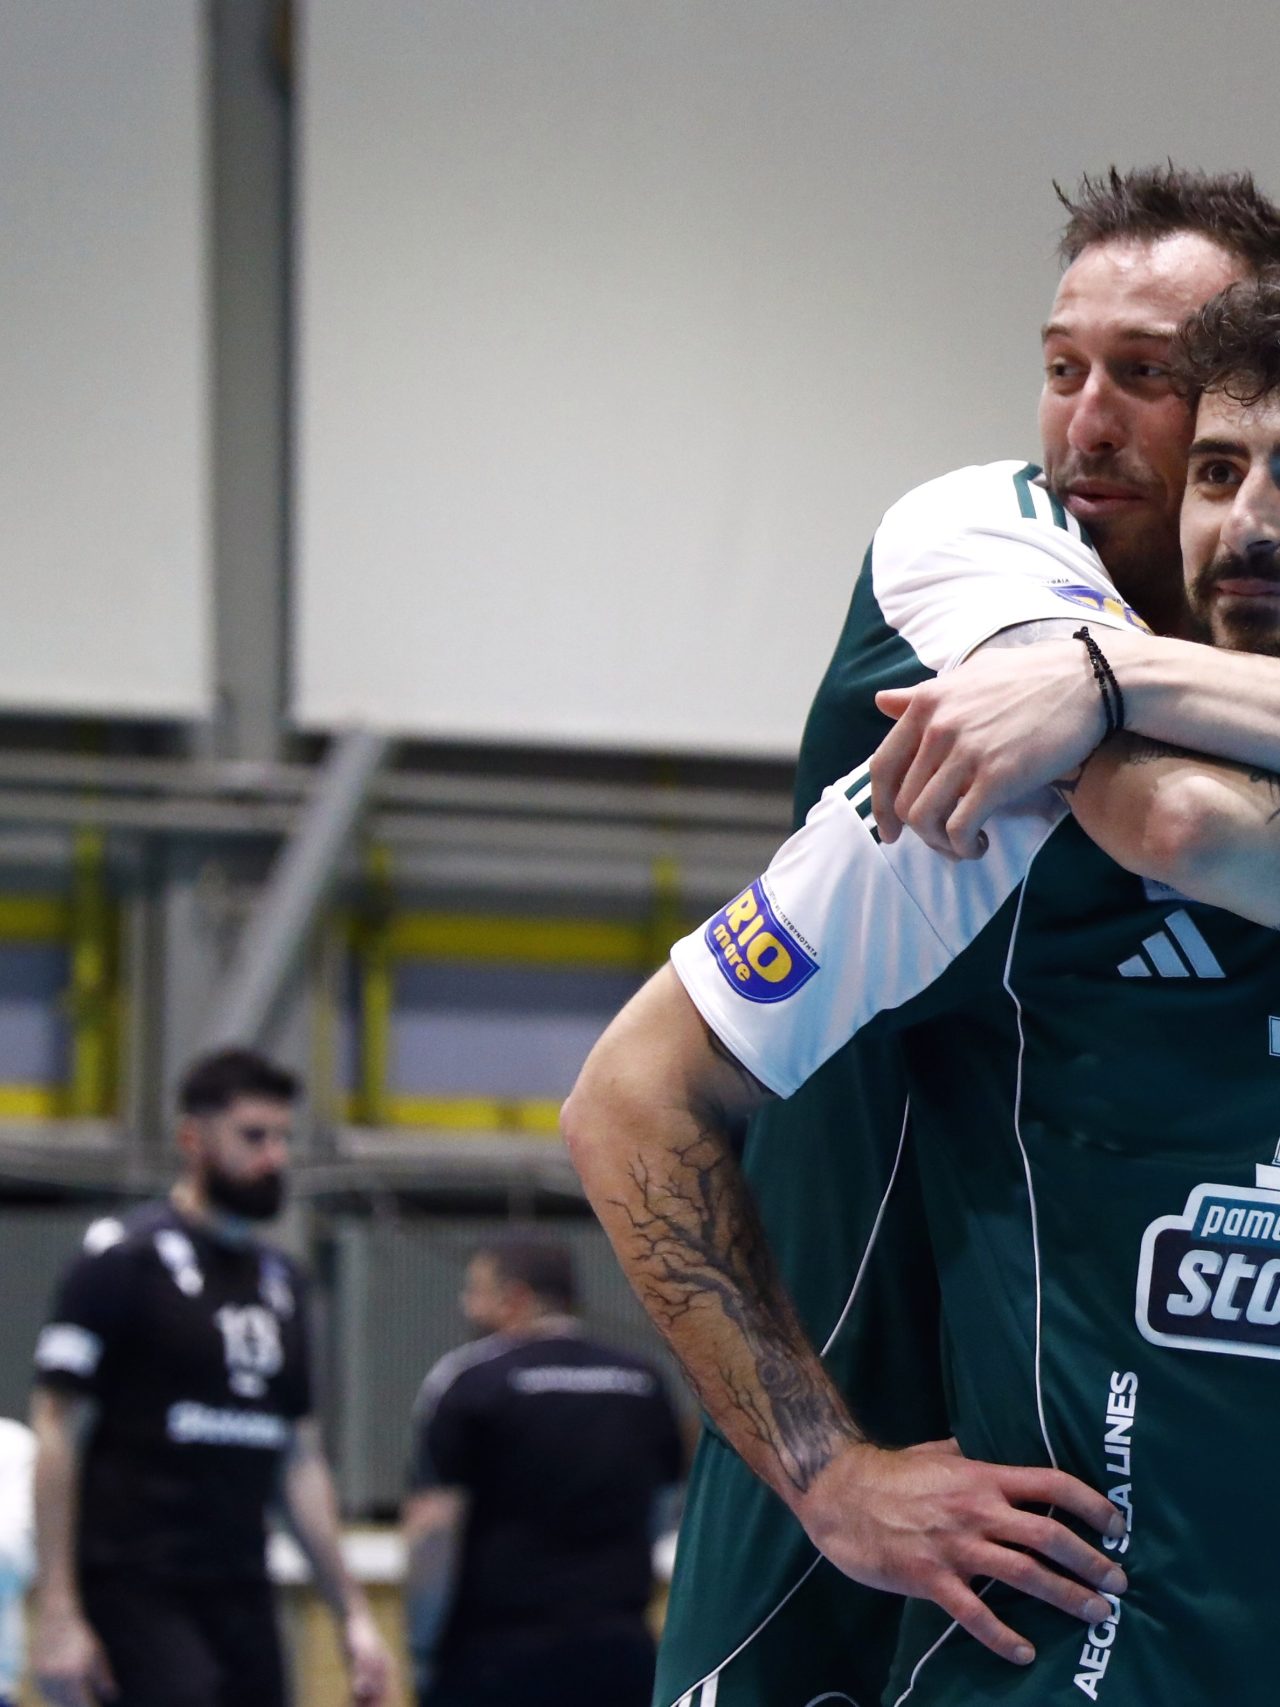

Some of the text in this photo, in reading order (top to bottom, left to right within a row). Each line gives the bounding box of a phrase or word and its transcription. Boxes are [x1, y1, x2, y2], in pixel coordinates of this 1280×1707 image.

[713, 923, 751, 982] mare
[725, 888, 793, 983] RIO
[1104, 1370, 1139, 1476] LINES
